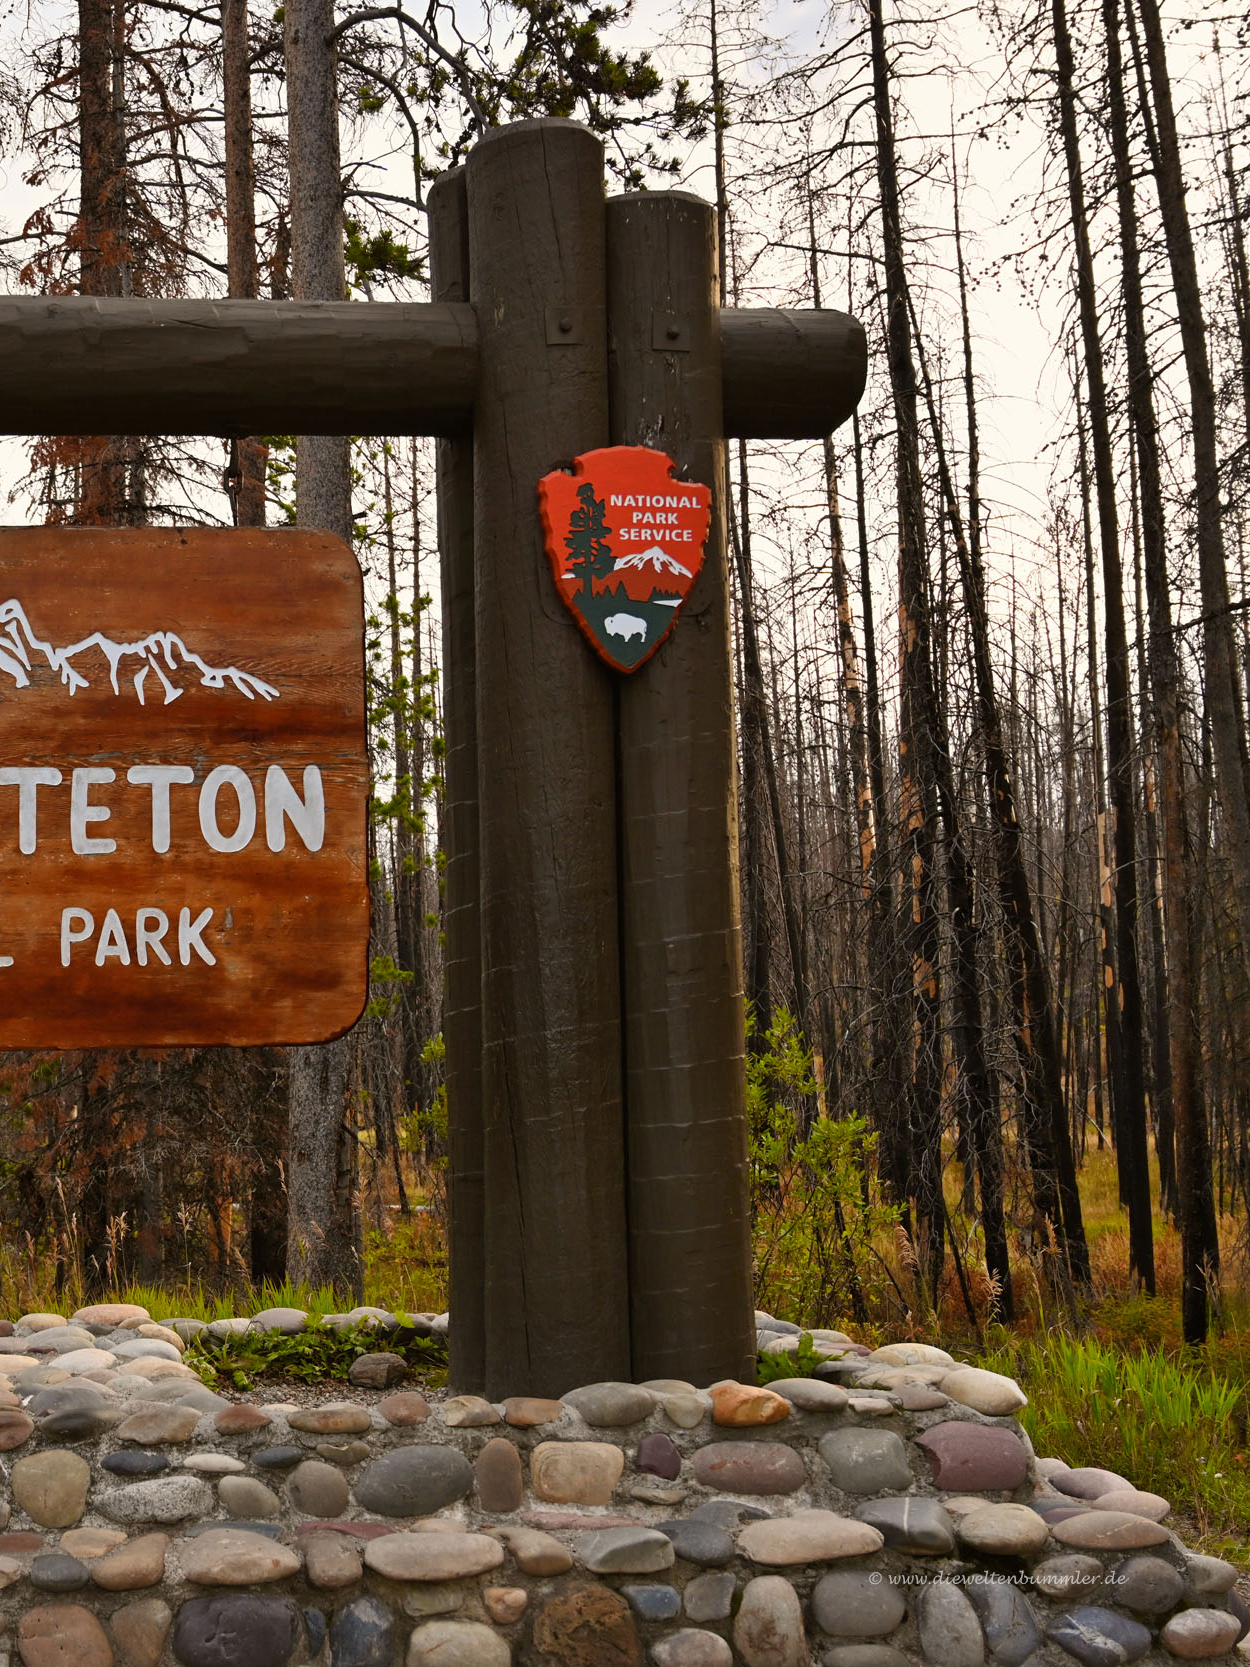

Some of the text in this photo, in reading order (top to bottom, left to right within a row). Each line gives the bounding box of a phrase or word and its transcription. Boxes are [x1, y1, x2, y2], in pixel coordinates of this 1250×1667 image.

[610, 494, 702, 509] NATIONAL
[632, 511, 679, 525] PARK
[619, 527, 693, 542] SERVICE
[60, 906, 217, 967] PARK
